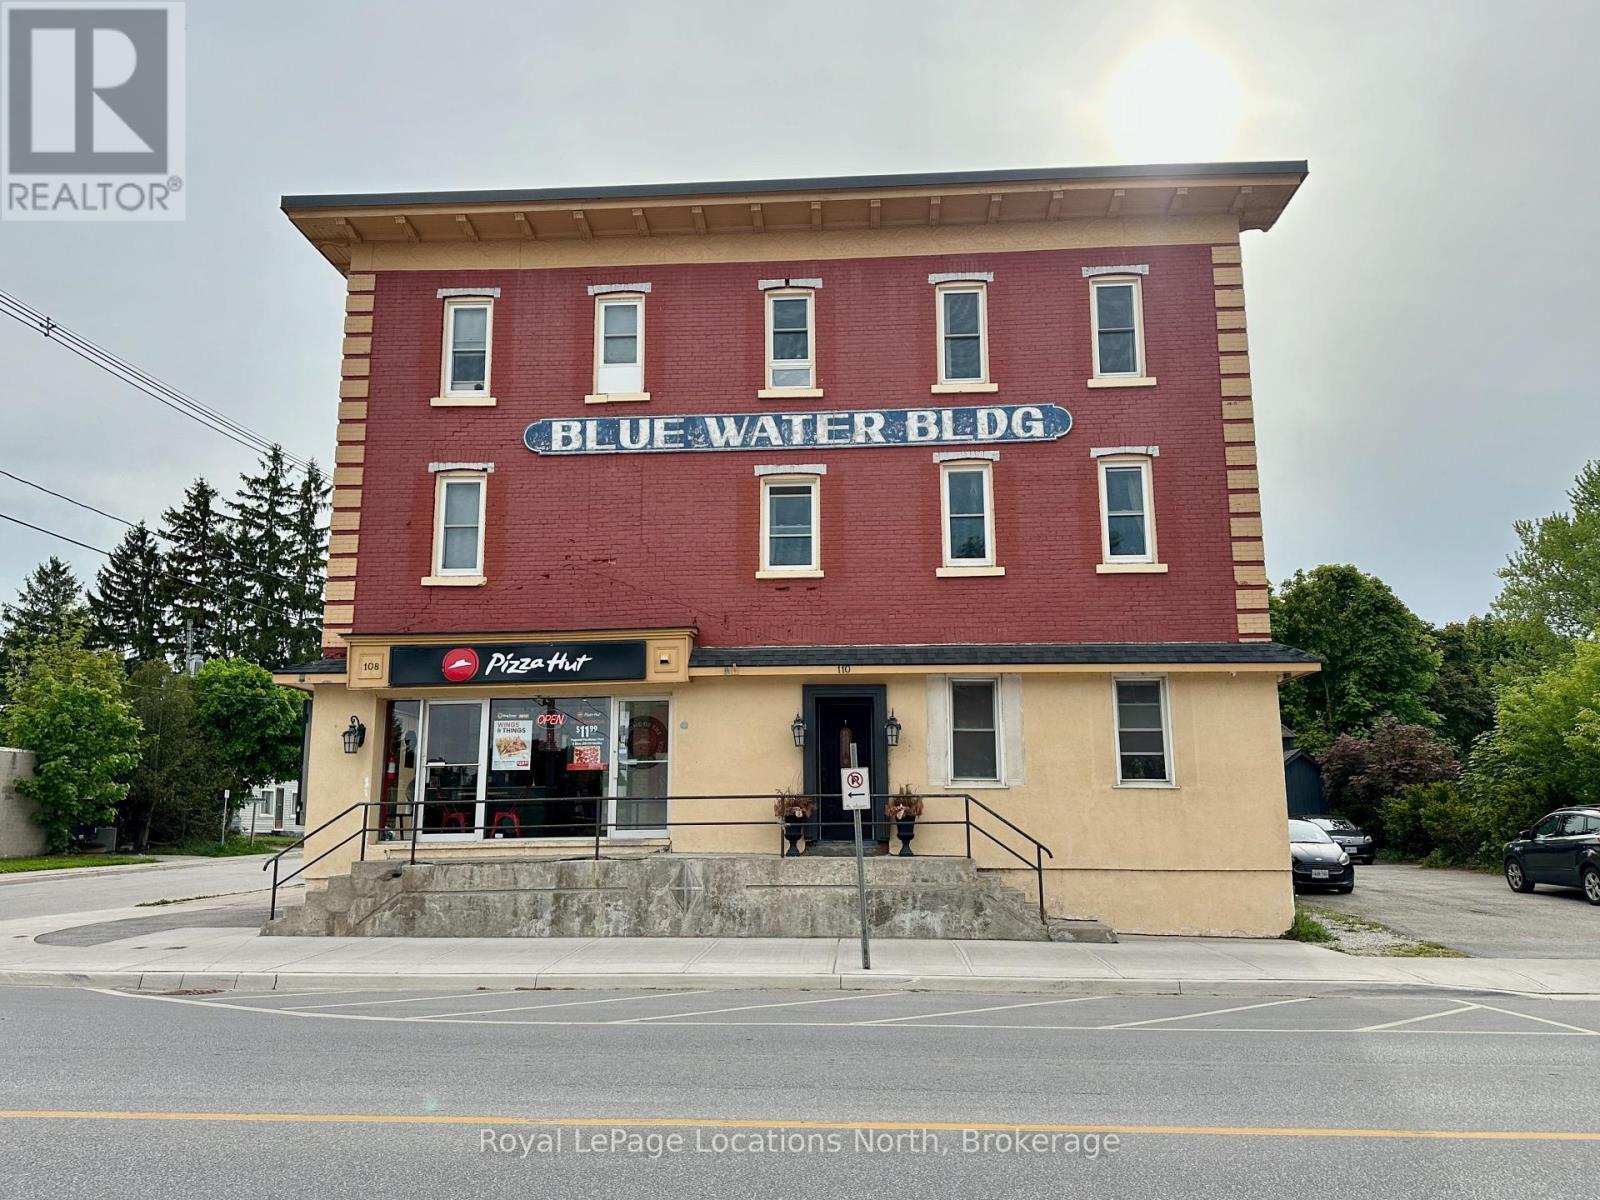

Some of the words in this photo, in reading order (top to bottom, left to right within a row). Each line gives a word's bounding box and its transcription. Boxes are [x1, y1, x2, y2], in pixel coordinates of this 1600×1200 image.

[551, 417, 684, 450] BLUE
[704, 411, 887, 448] WATER
[906, 406, 1045, 442] BLDG
[363, 662, 380, 671] 108
[485, 652, 545, 676] Pizza
[547, 651, 592, 673] Hut
[838, 665, 850, 673] 110
[538, 713, 565, 725] OPEN
